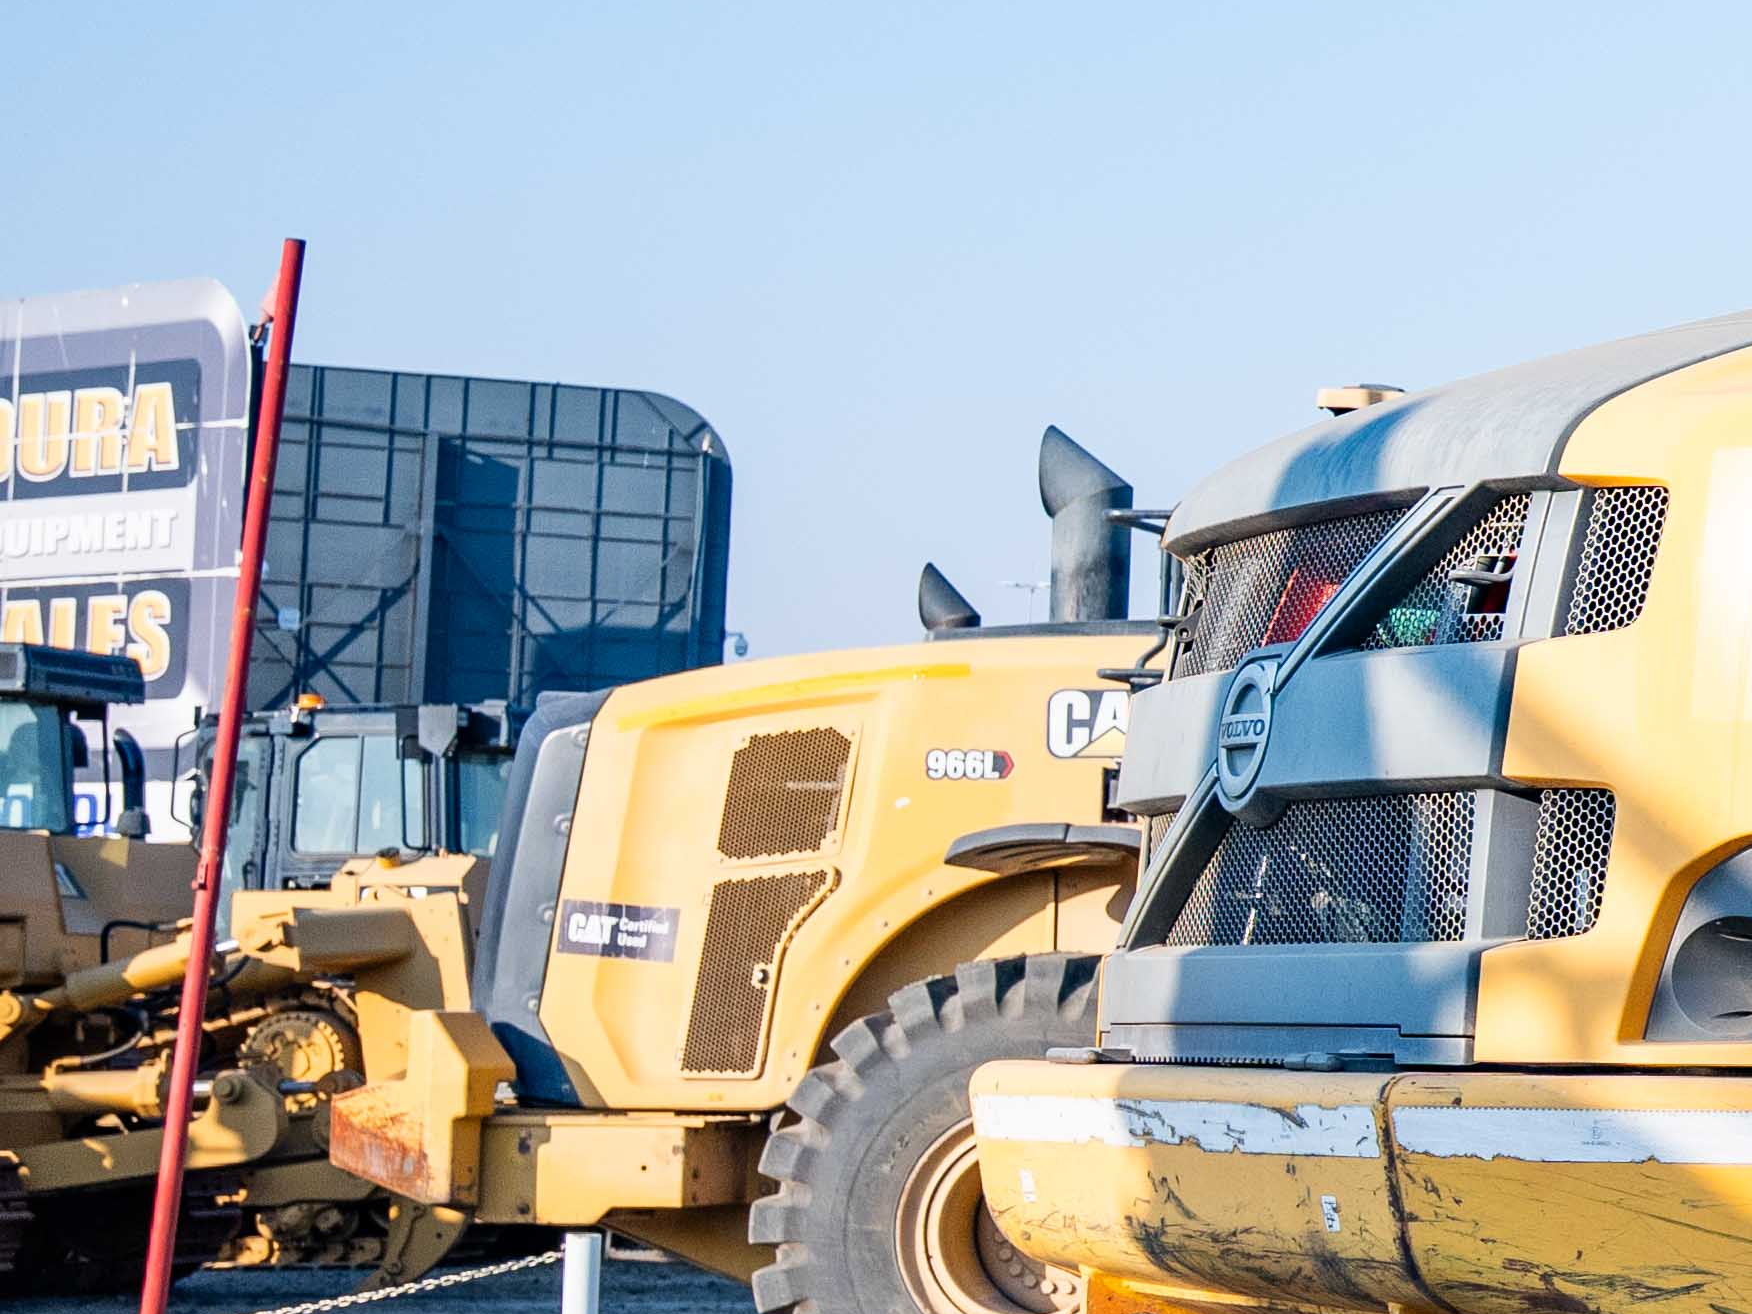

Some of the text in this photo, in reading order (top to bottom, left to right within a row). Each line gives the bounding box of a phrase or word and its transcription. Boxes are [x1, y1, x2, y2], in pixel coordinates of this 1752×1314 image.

[0, 382, 180, 482] URA
[0, 508, 178, 561] UIPMENT
[1221, 718, 1265, 739] VOLVO
[926, 749, 1001, 780] 966L
[568, 912, 619, 945] CAT
